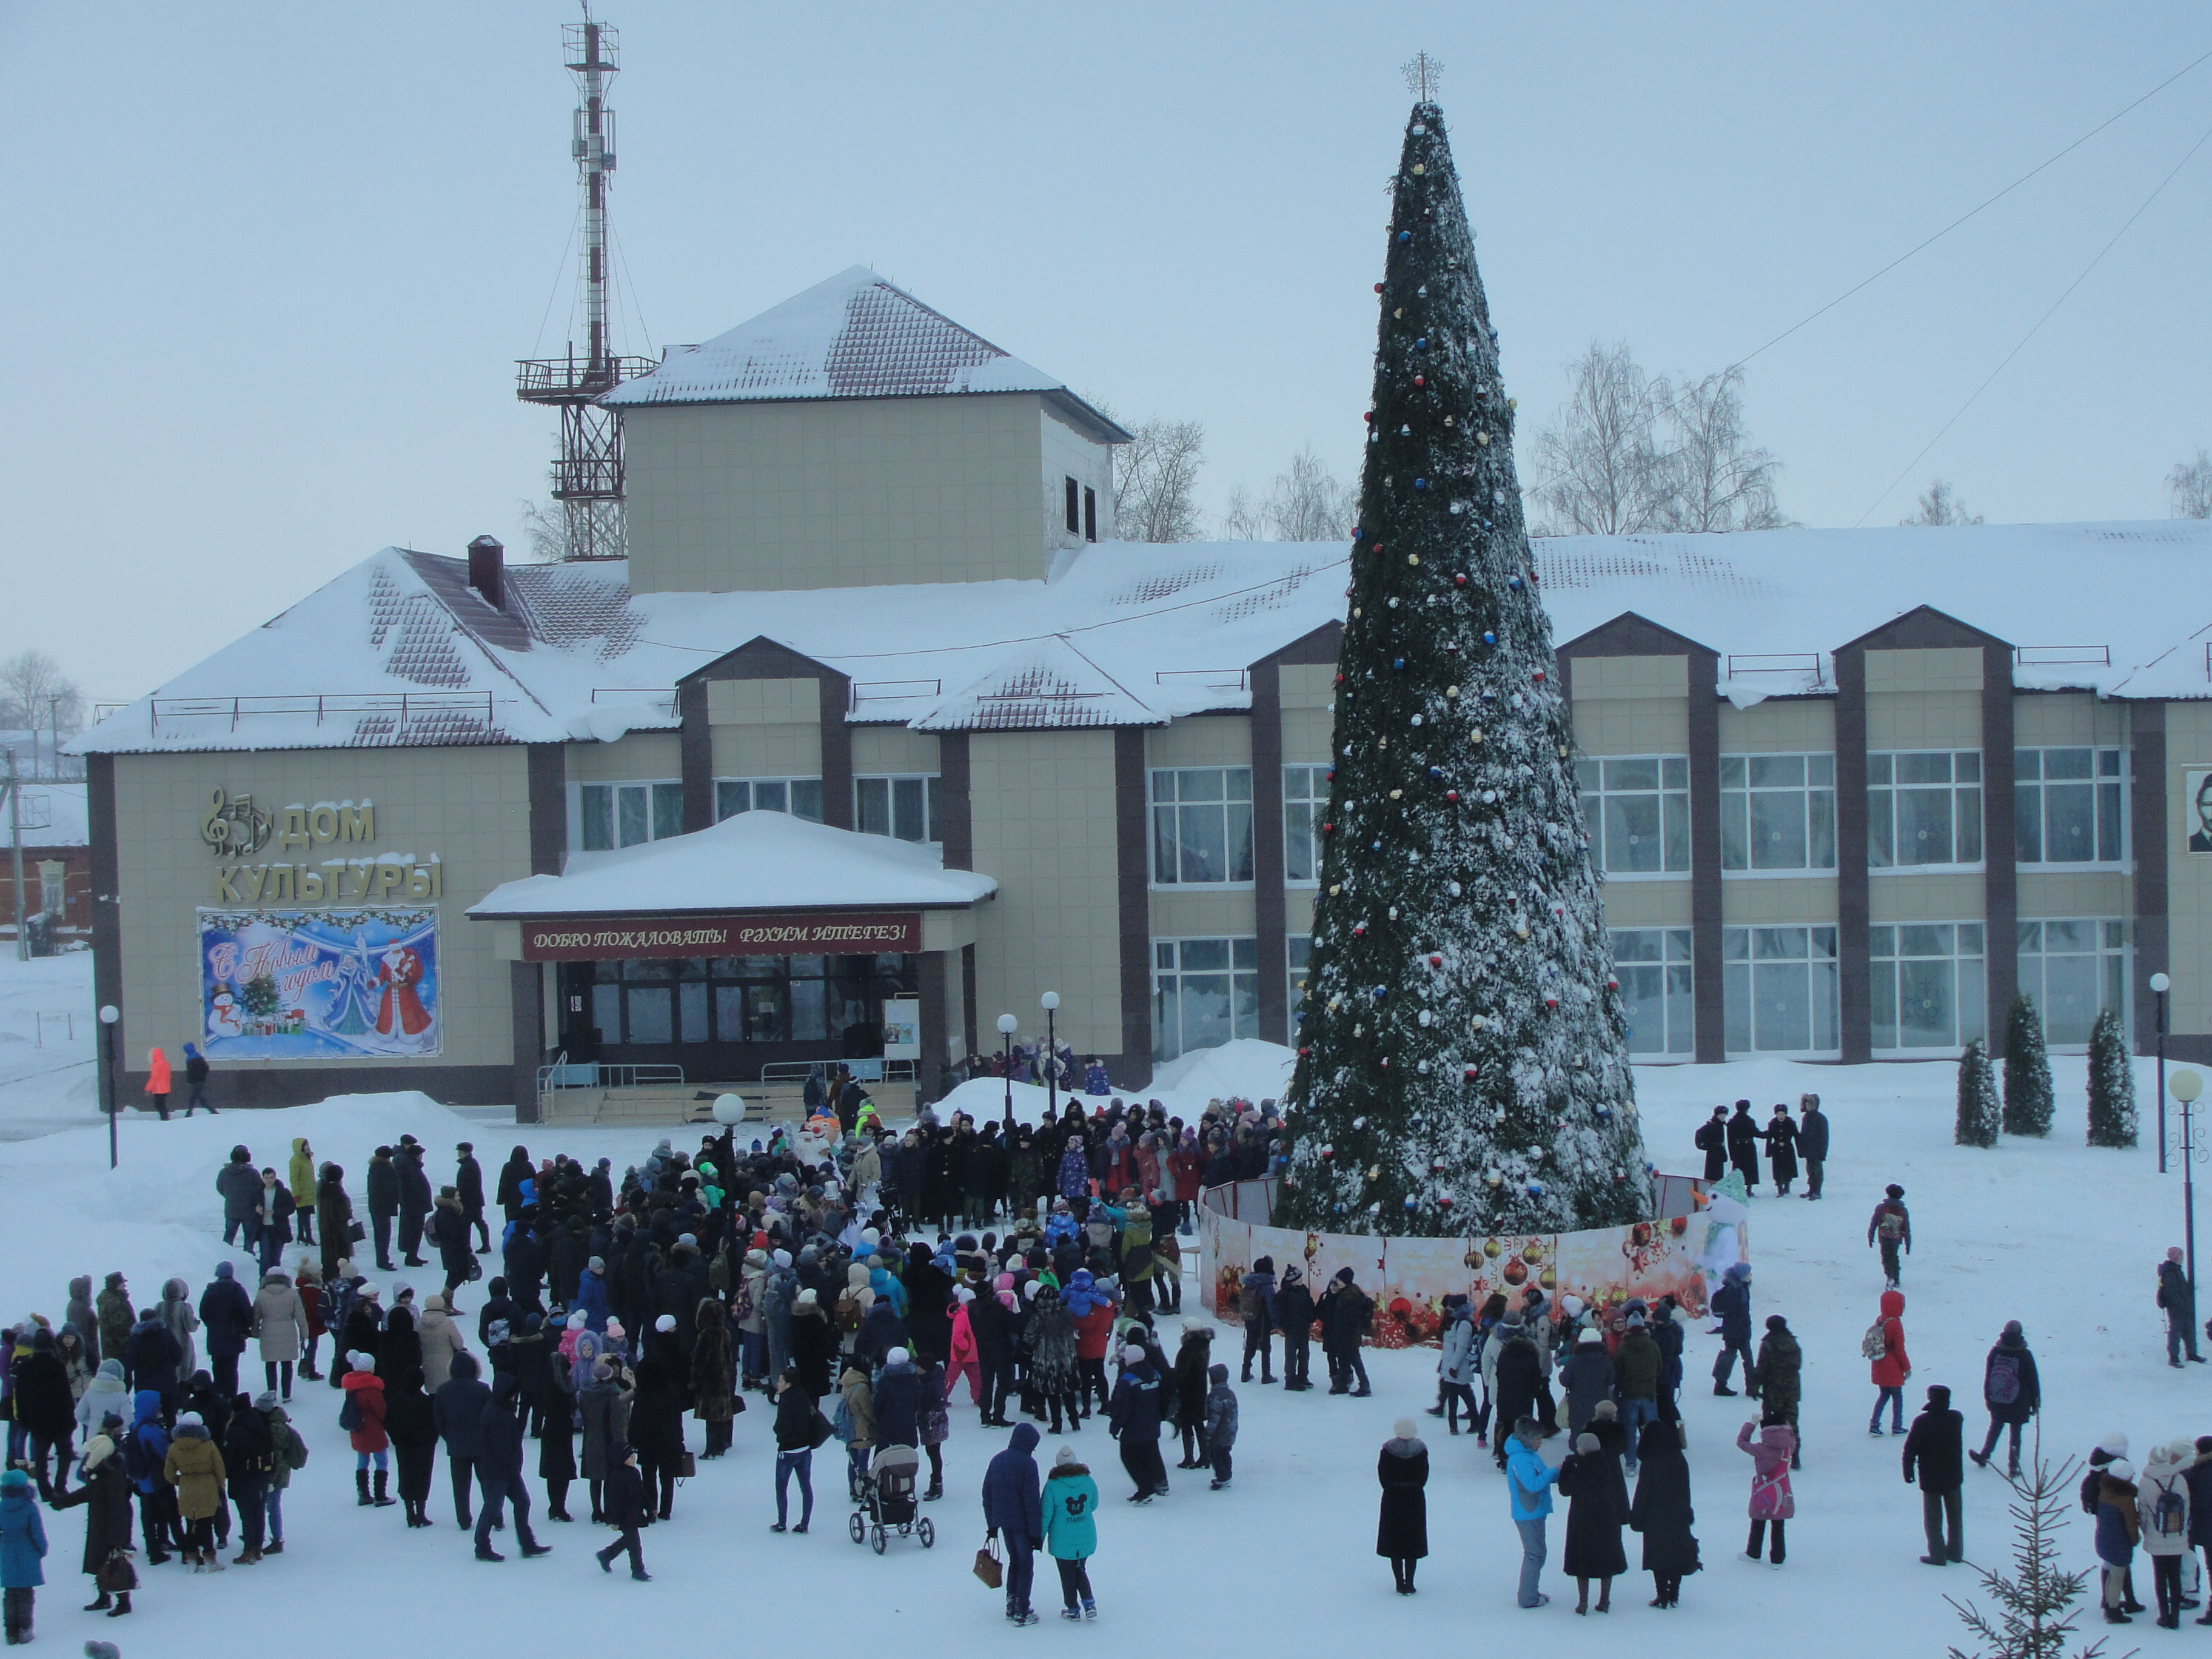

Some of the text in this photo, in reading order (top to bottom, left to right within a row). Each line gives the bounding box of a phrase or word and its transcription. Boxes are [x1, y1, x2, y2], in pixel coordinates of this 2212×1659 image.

[279, 803, 375, 850] ДОМ
[215, 860, 442, 903] КУЛЬТУРЫ
[534, 925, 907, 948] ДОБРО ПОЖАЛОВАТЬ! РӘХИМ ИТЕГЕЗ!
[209, 940, 317, 983] С Новым
[283, 962, 335, 1002] годом
